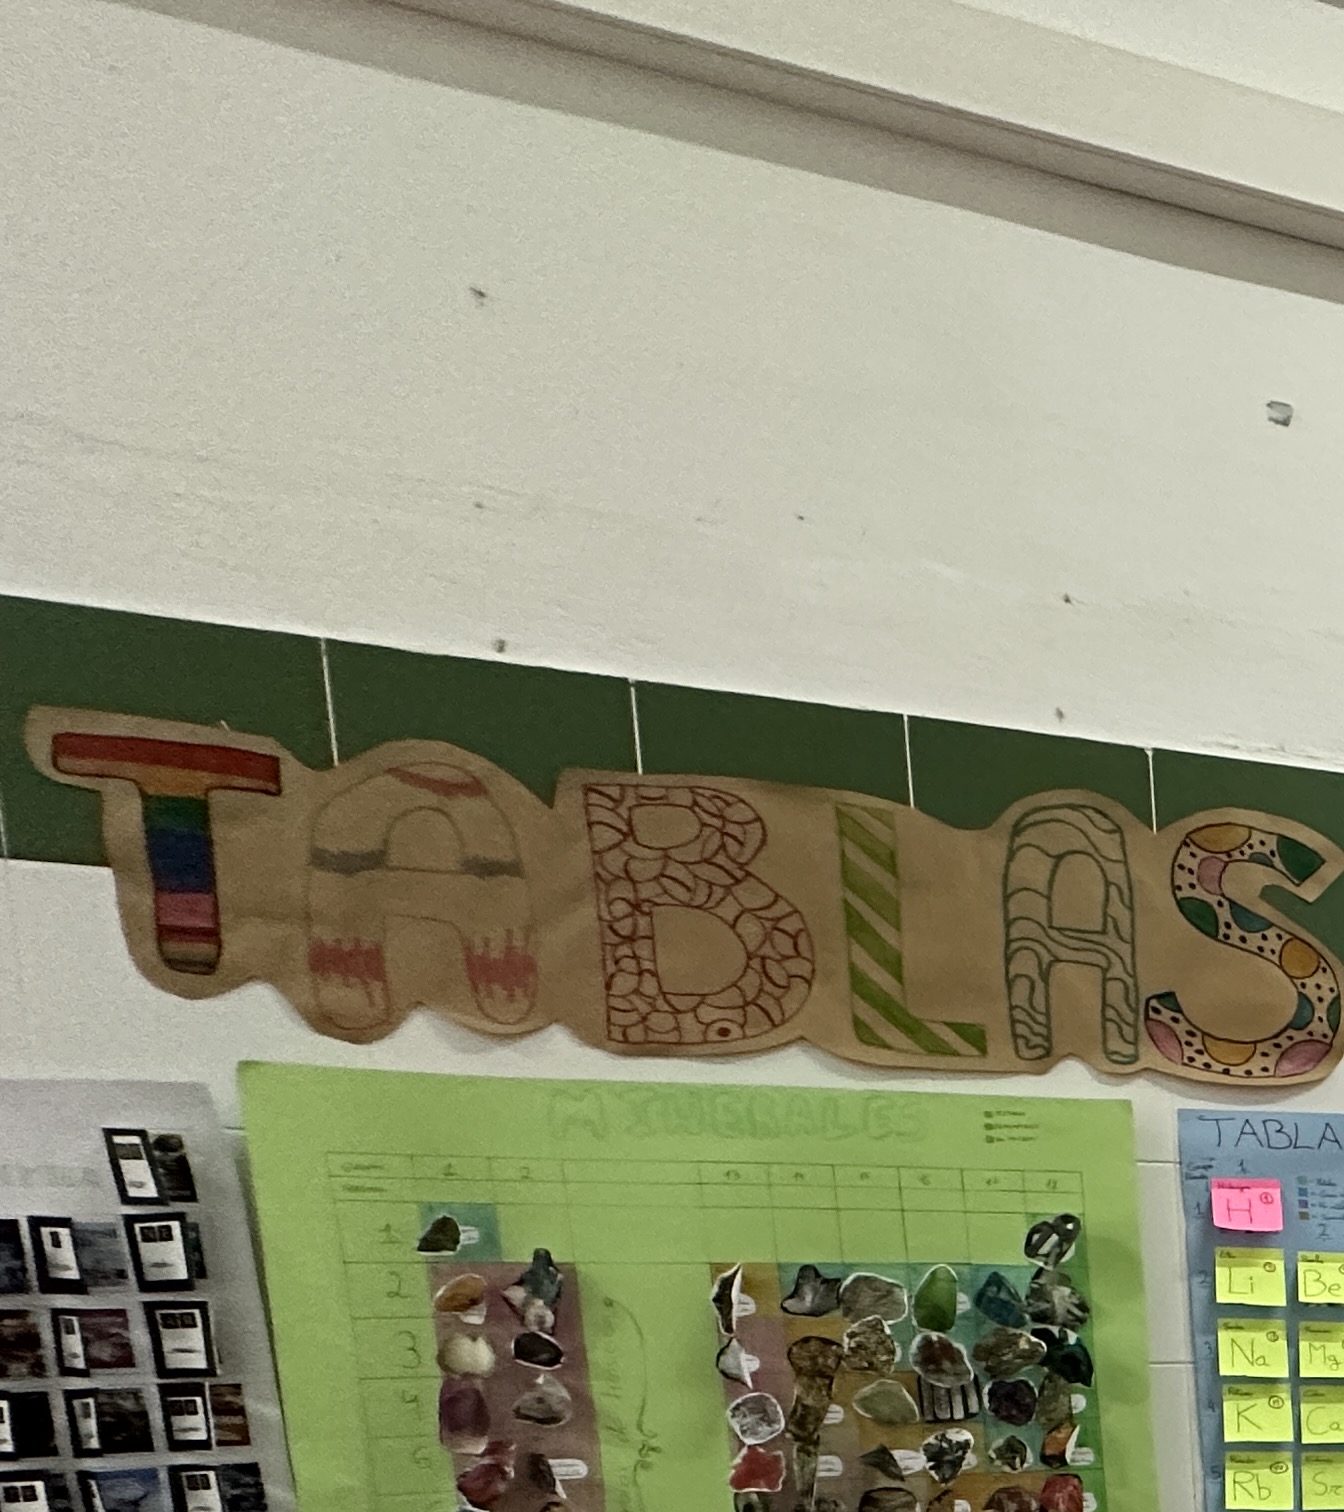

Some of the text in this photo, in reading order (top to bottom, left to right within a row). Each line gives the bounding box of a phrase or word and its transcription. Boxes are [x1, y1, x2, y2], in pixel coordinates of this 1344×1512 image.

[52, 730, 1344, 1080] TABLAS
[1198, 1116, 1344, 1150] TABLA
[1226, 1198, 1253, 1224] H
[386, 1271, 411, 1298] 2
[1228, 1266, 1255, 1296] Li
[1303, 1268, 1343, 1298] Be
[396, 1330, 422, 1370] 3
[1231, 1337, 1271, 1369] Na
[1308, 1341, 1344, 1372] Mg
[1236, 1403, 1263, 1434] K
[1306, 1406, 1344, 1436] Ca
[1233, 1470, 1273, 1502] Rb
[1312, 1471, 1344, 1497] Sr
